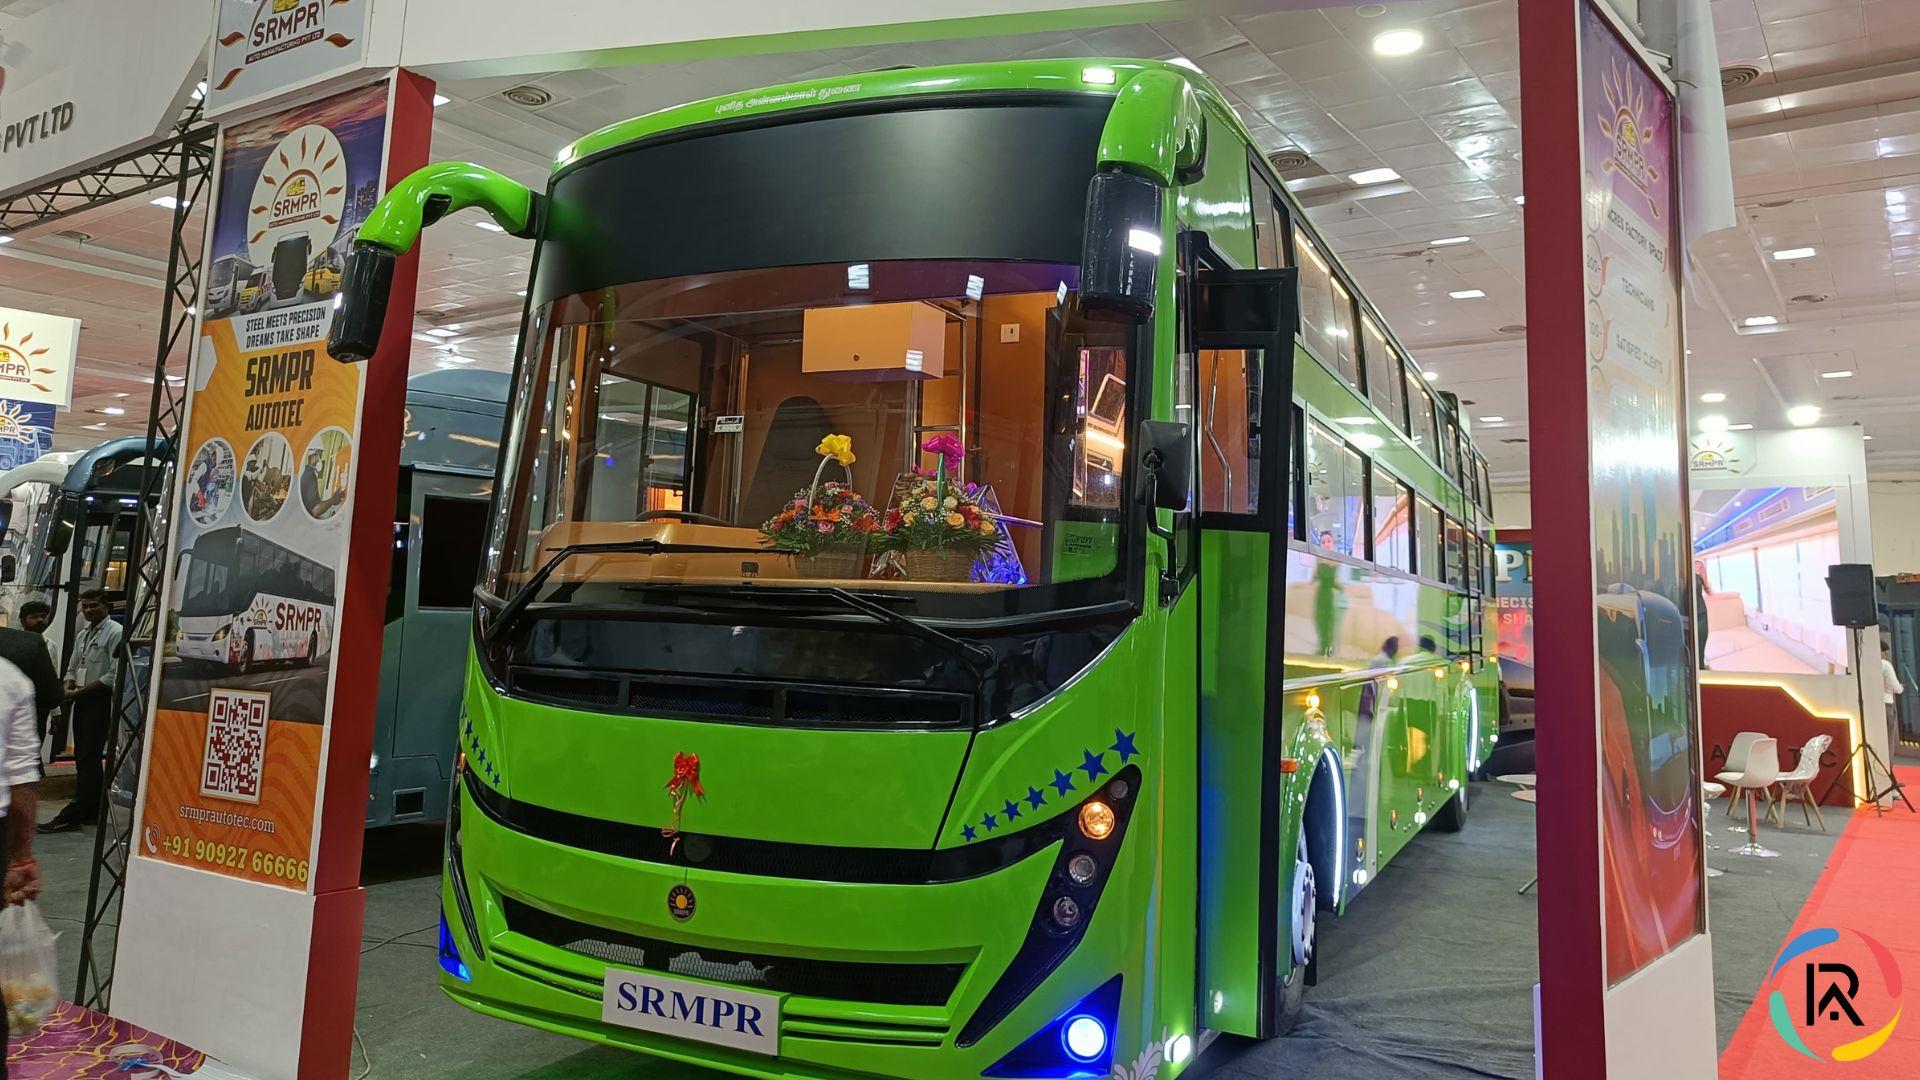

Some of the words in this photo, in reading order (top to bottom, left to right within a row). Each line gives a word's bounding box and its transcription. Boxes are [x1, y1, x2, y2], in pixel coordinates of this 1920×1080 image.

[252, 1, 320, 47] SRMPR
[3, 114, 40, 154] PVT
[40, 101, 74, 140] LTD
[273, 191, 318, 218] SRMPR
[246, 319, 265, 333] STEEL
[266, 313, 288, 330] MEETS
[288, 306, 327, 325] PRECISION
[246, 332, 274, 349] DREAMS
[276, 328, 295, 344] TAKE
[296, 324, 320, 341] SHAPE
[245, 349, 315, 397] SRMPR
[245, 399, 304, 431] AUTOTEC
[275, 602, 322, 632] SRMPR
[180, 804, 275, 832] srmprautotec.com
[162, 834, 191, 858] +91
[194, 839, 249, 870] 90927
[252, 850, 309, 883] 66666
[617, 981, 765, 1037] SRMPR
